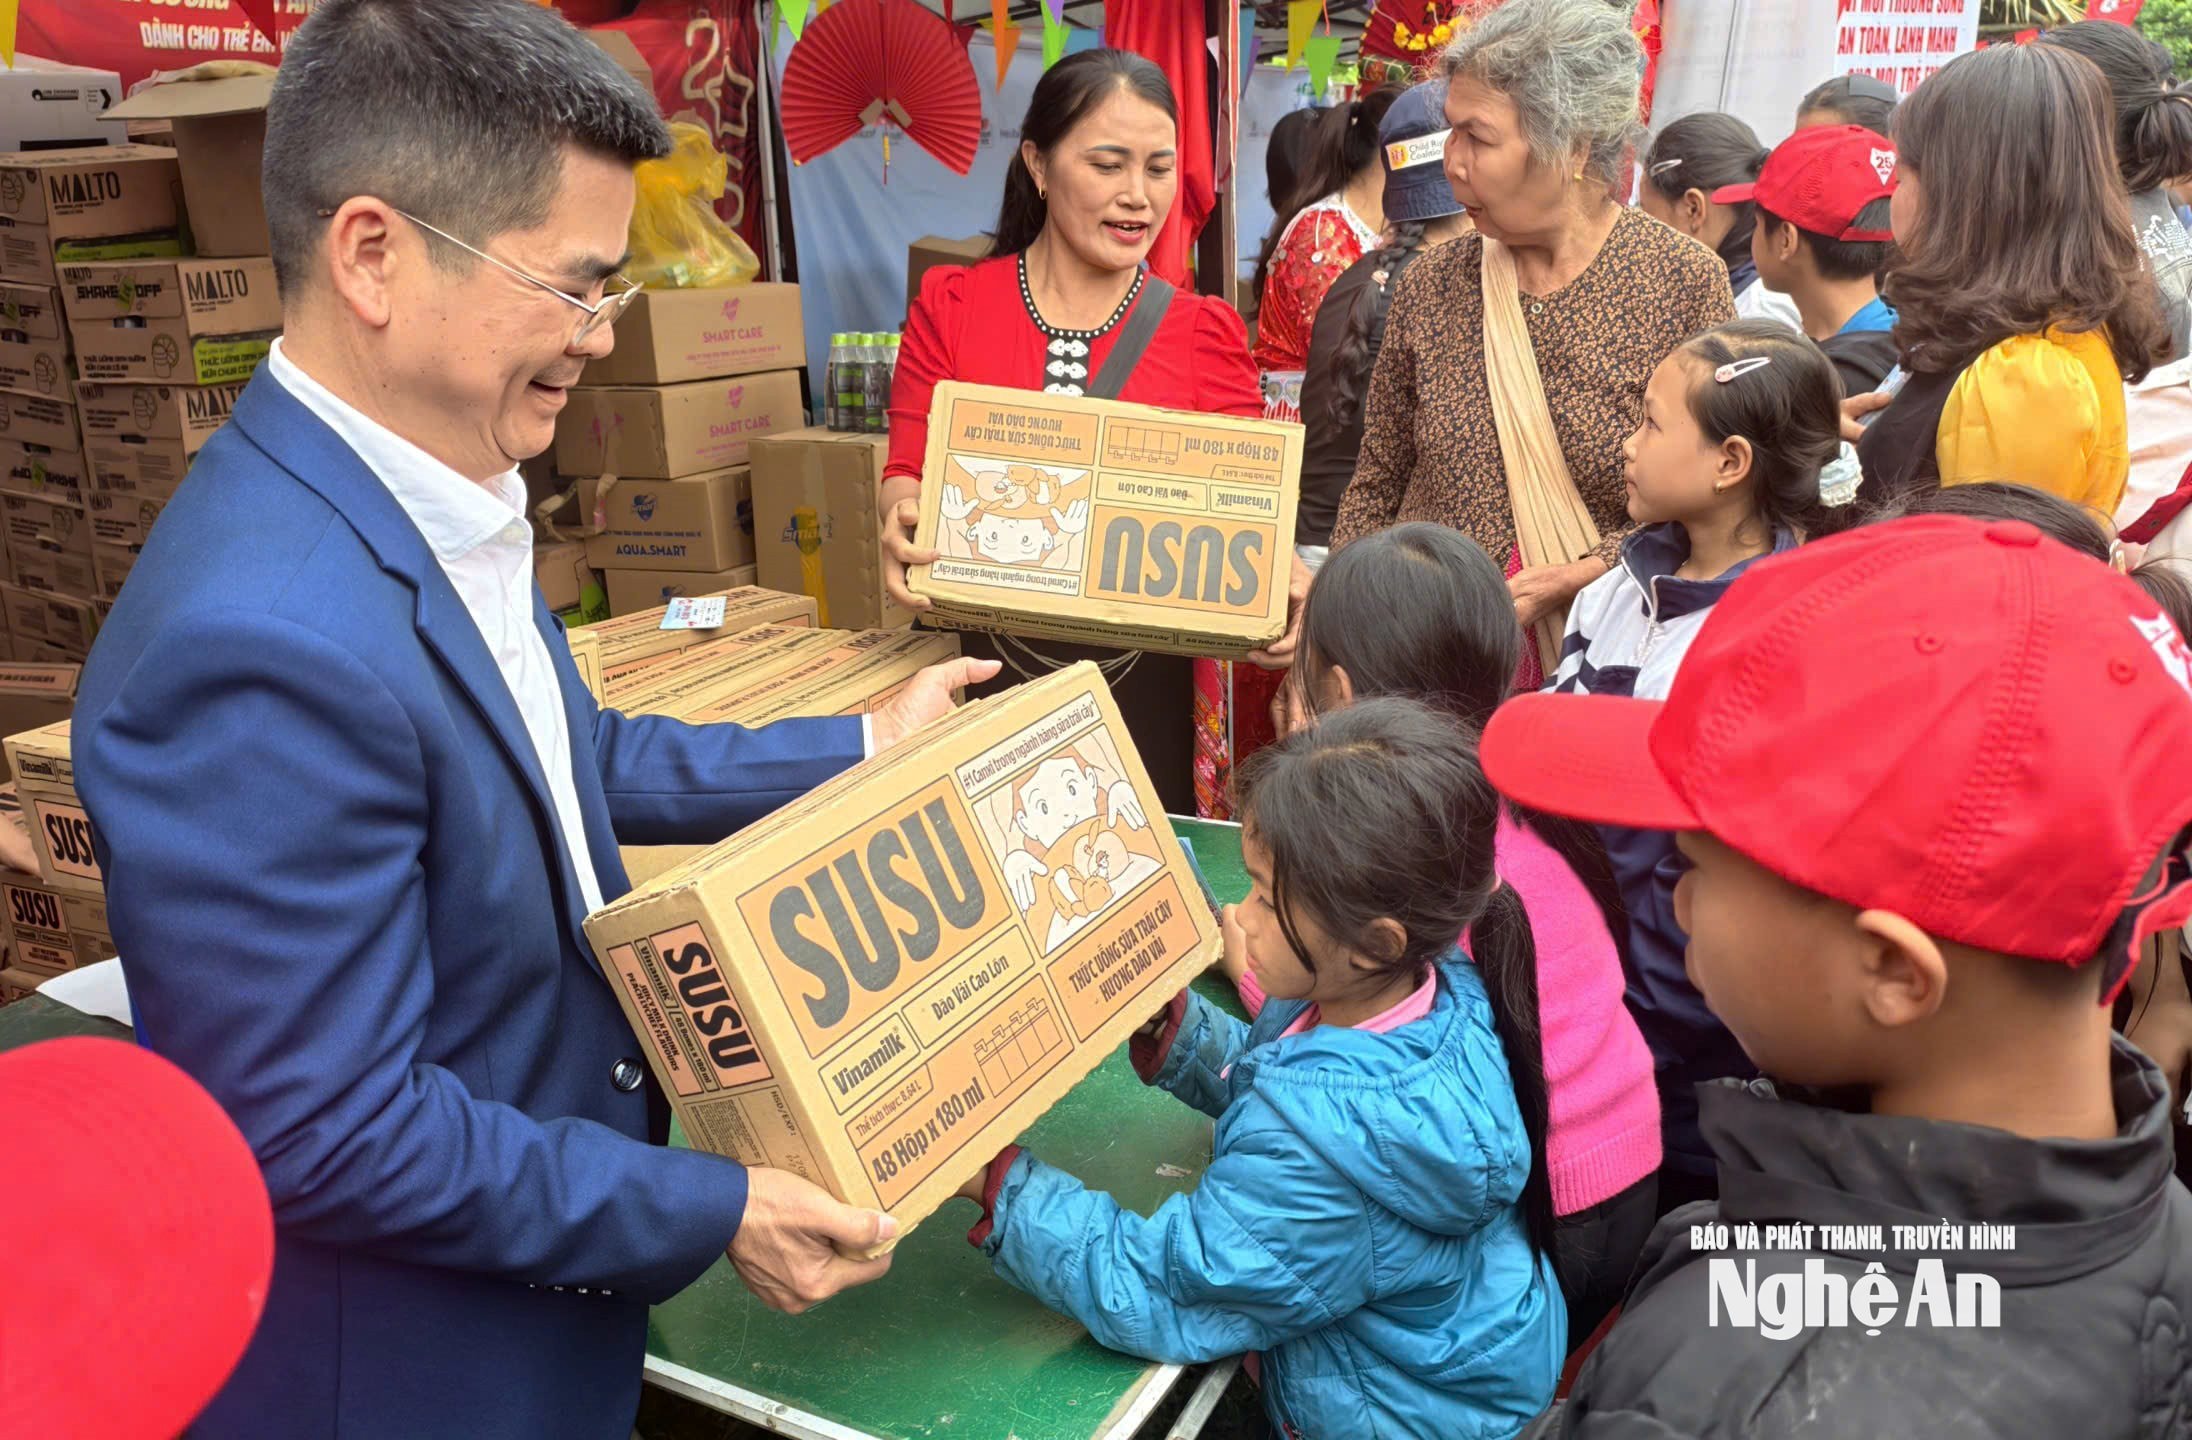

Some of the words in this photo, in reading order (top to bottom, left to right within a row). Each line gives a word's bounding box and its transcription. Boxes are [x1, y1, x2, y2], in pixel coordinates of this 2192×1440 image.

[140, 16, 184, 49] DÀNH
[187, 24, 219, 51] CHO
[222, 20, 250, 52] TRẺ
[1837, 26, 1855, 54] AN
[1859, 20, 1891, 56] TOÀN,
[1895, 20, 1925, 54] LÀNH
[1926, 26, 1958, 57] MẠNH
[1875, 156, 1893, 169] 25
[50, 171, 121, 204] MALTO
[185, 269, 249, 301] MALTO
[702, 329, 737, 343] SMART
[737, 326, 763, 340] CARE
[709, 420, 742, 438] SMART
[745, 415, 771, 430] CARE
[1184, 437, 1201, 452] ml
[1202, 439, 1225, 454] 180
[1236, 442, 1261, 461] Hộp
[1262, 445, 1279, 462] 48
[1137, 484, 1153, 497] Cao
[1217, 491, 1272, 511] Vinamilk
[1097, 515, 1264, 607] SUSU
[847, 631, 894, 649] SUSU
[963, 771, 976, 790] #1
[972, 761, 996, 787] Canxi
[992, 752, 1017, 773] trong
[1014, 735, 1041, 761] ngành
[1036, 726, 1059, 747] hàng
[1056, 715, 1072, 737] sữa
[1067, 708, 1082, 728] trái
[10, 887, 60, 929] SUSU
[768, 794, 986, 1030] SUSU
[1068, 960, 1098, 993] THỨC
[1093, 943, 1122, 974] UỐNG
[1118, 928, 1139, 955] SỮA
[1134, 910, 1159, 940] TRÁI
[1154, 899, 1173, 925] CÂY
[640, 946, 671, 1001] Vinamilk
[952, 979, 973, 1005] Vải
[969, 968, 990, 993] Cao
[985, 955, 1010, 979] Lớn
[1098, 962, 1135, 1003] HƯƠNG
[626, 972, 644, 1000] PEACH
[640, 998, 657, 1028] LYCHEE
[654, 1028, 680, 1071] FLAVOURS
[639, 983, 654, 1007] JUICY
[650, 1005, 665, 1028] MILK
[660, 1028, 681, 1056] DRINK
[662, 942, 761, 1070] SUSU
[678, 1026, 695, 1053] Boxes
[694, 1056, 706, 1073] 180
[702, 1072, 712, 1084] ml
[831, 1028, 906, 1096] Vinamilk
[914, 1079, 922, 1090] L
[770, 1090, 797, 1137] HSD/EXP:
[871, 1149, 899, 1184] 48
[891, 1128, 929, 1169] Hộp
[924, 1118, 942, 1143] x
[935, 1093, 966, 1132] 180
[961, 1076, 985, 1111] ml
